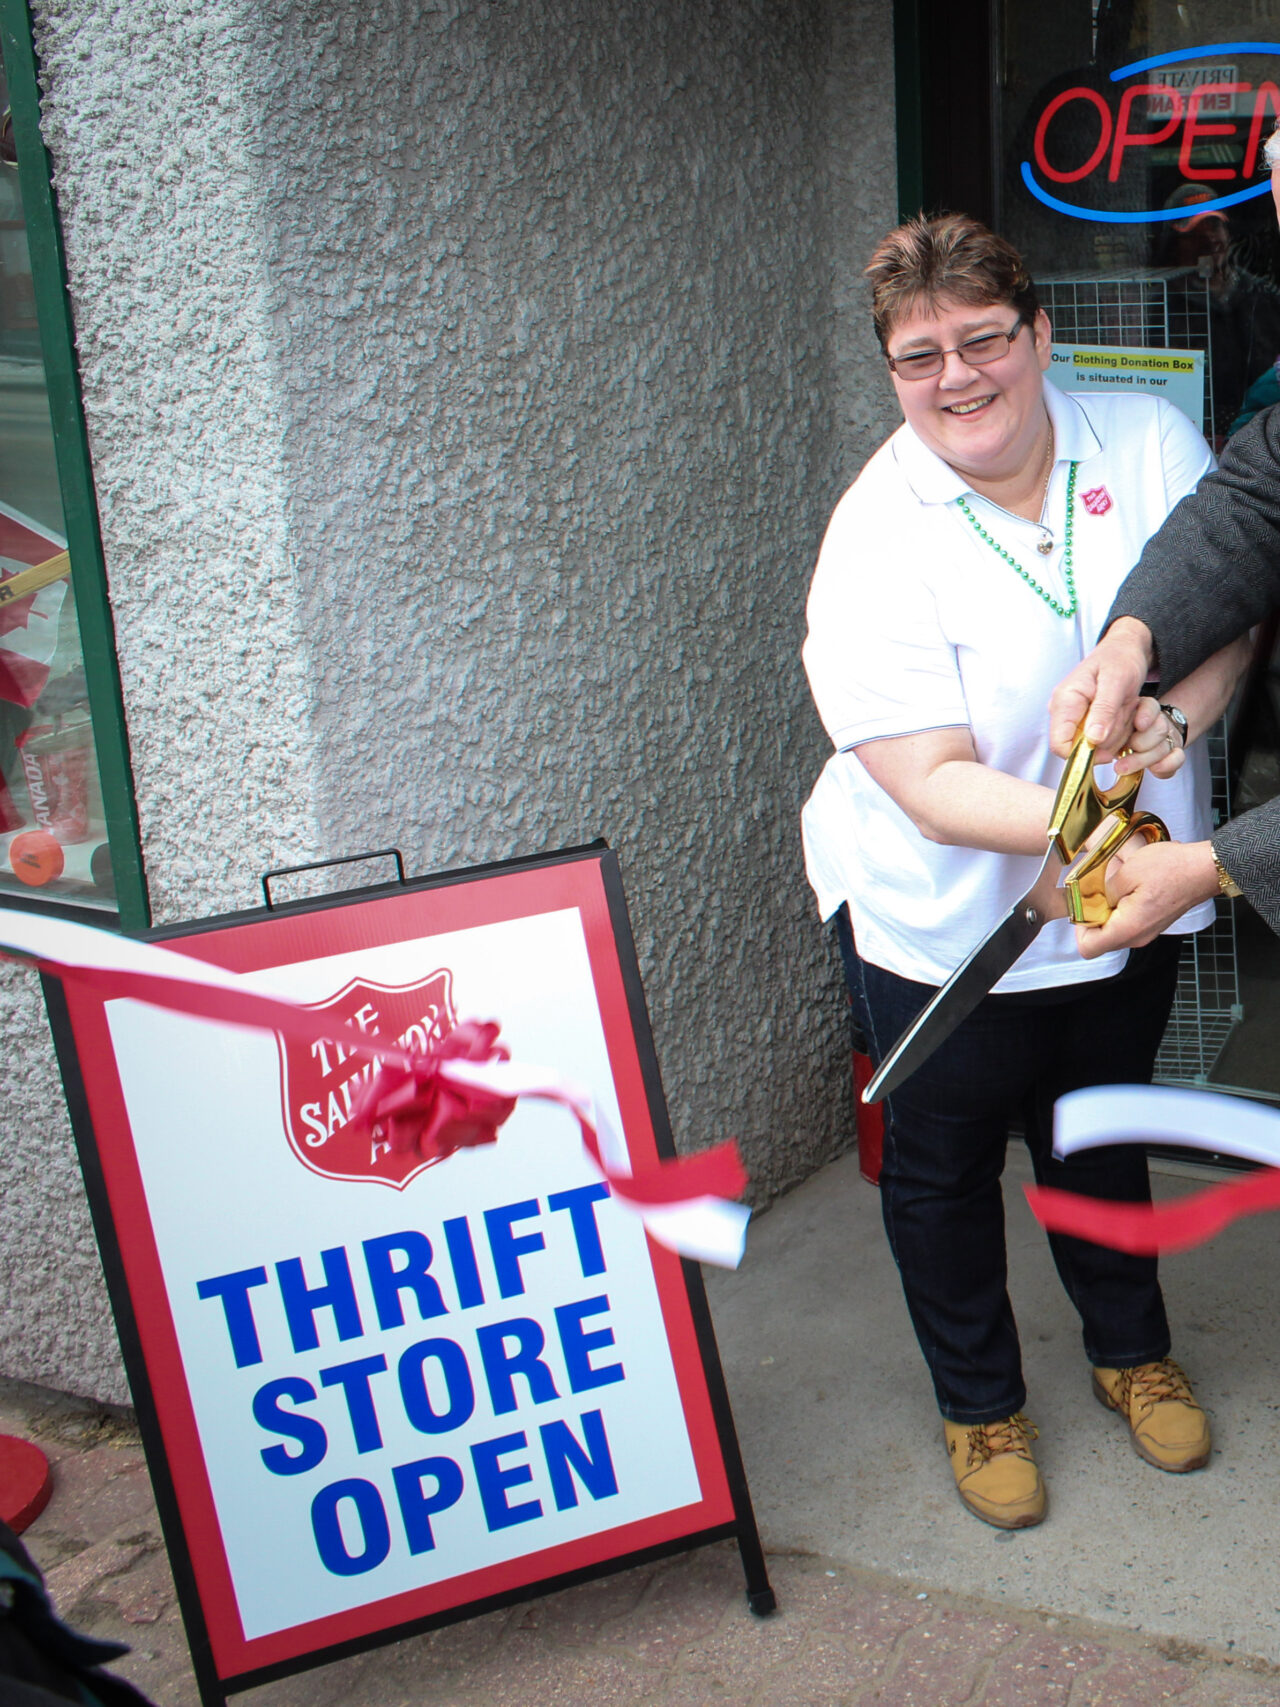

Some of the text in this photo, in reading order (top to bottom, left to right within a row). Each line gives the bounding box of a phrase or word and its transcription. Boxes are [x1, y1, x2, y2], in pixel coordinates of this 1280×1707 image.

[1051, 353, 1194, 370] Our Clothing Donation Box
[1076, 372, 1168, 386] is situated in our
[24, 753, 53, 826] ANADA
[197, 1182, 611, 1369] THRIFT
[251, 1294, 625, 1476] STORE
[309, 1408, 621, 1578] OPEN
